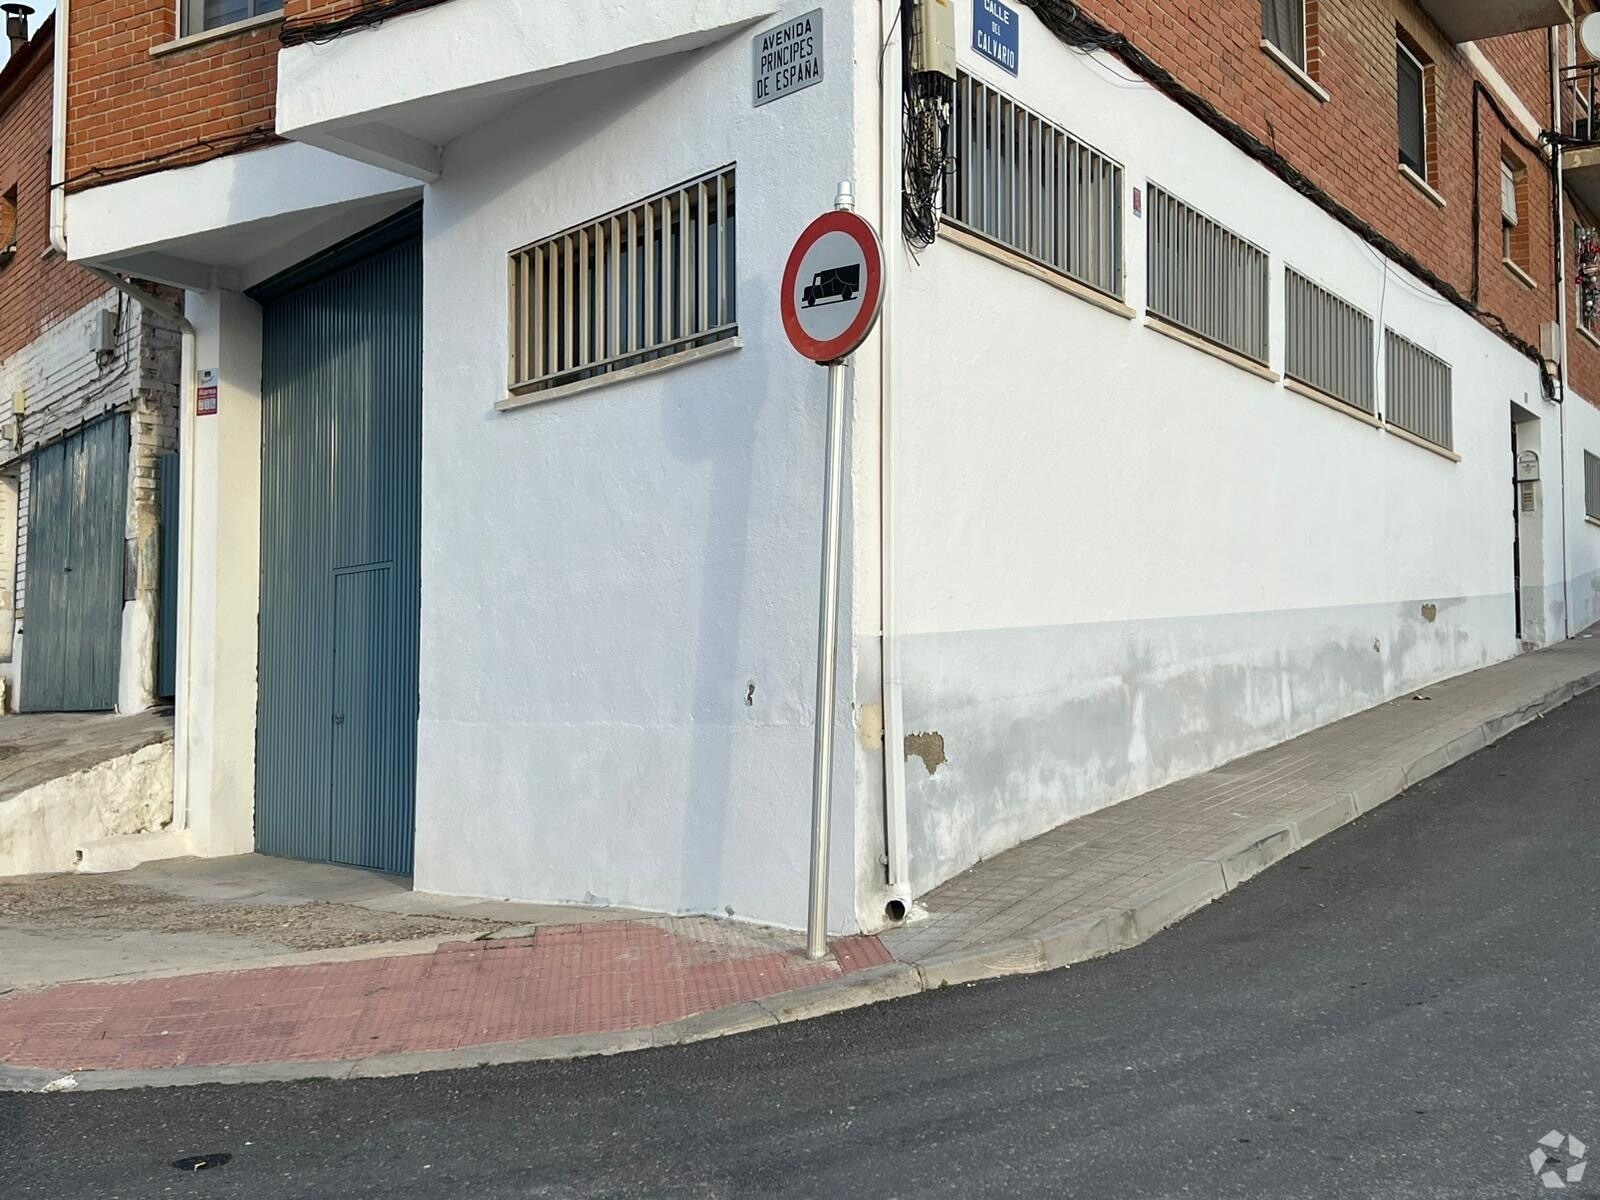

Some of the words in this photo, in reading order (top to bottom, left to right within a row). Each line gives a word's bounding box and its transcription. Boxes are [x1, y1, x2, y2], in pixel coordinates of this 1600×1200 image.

[983, 0, 1010, 25] CALLE
[762, 18, 812, 53] AVENIDA
[977, 29, 1015, 69] CALVARIO
[761, 36, 813, 75] PRINCIPES
[757, 76, 769, 99] DE
[776, 57, 819, 91] ESPAÑA
